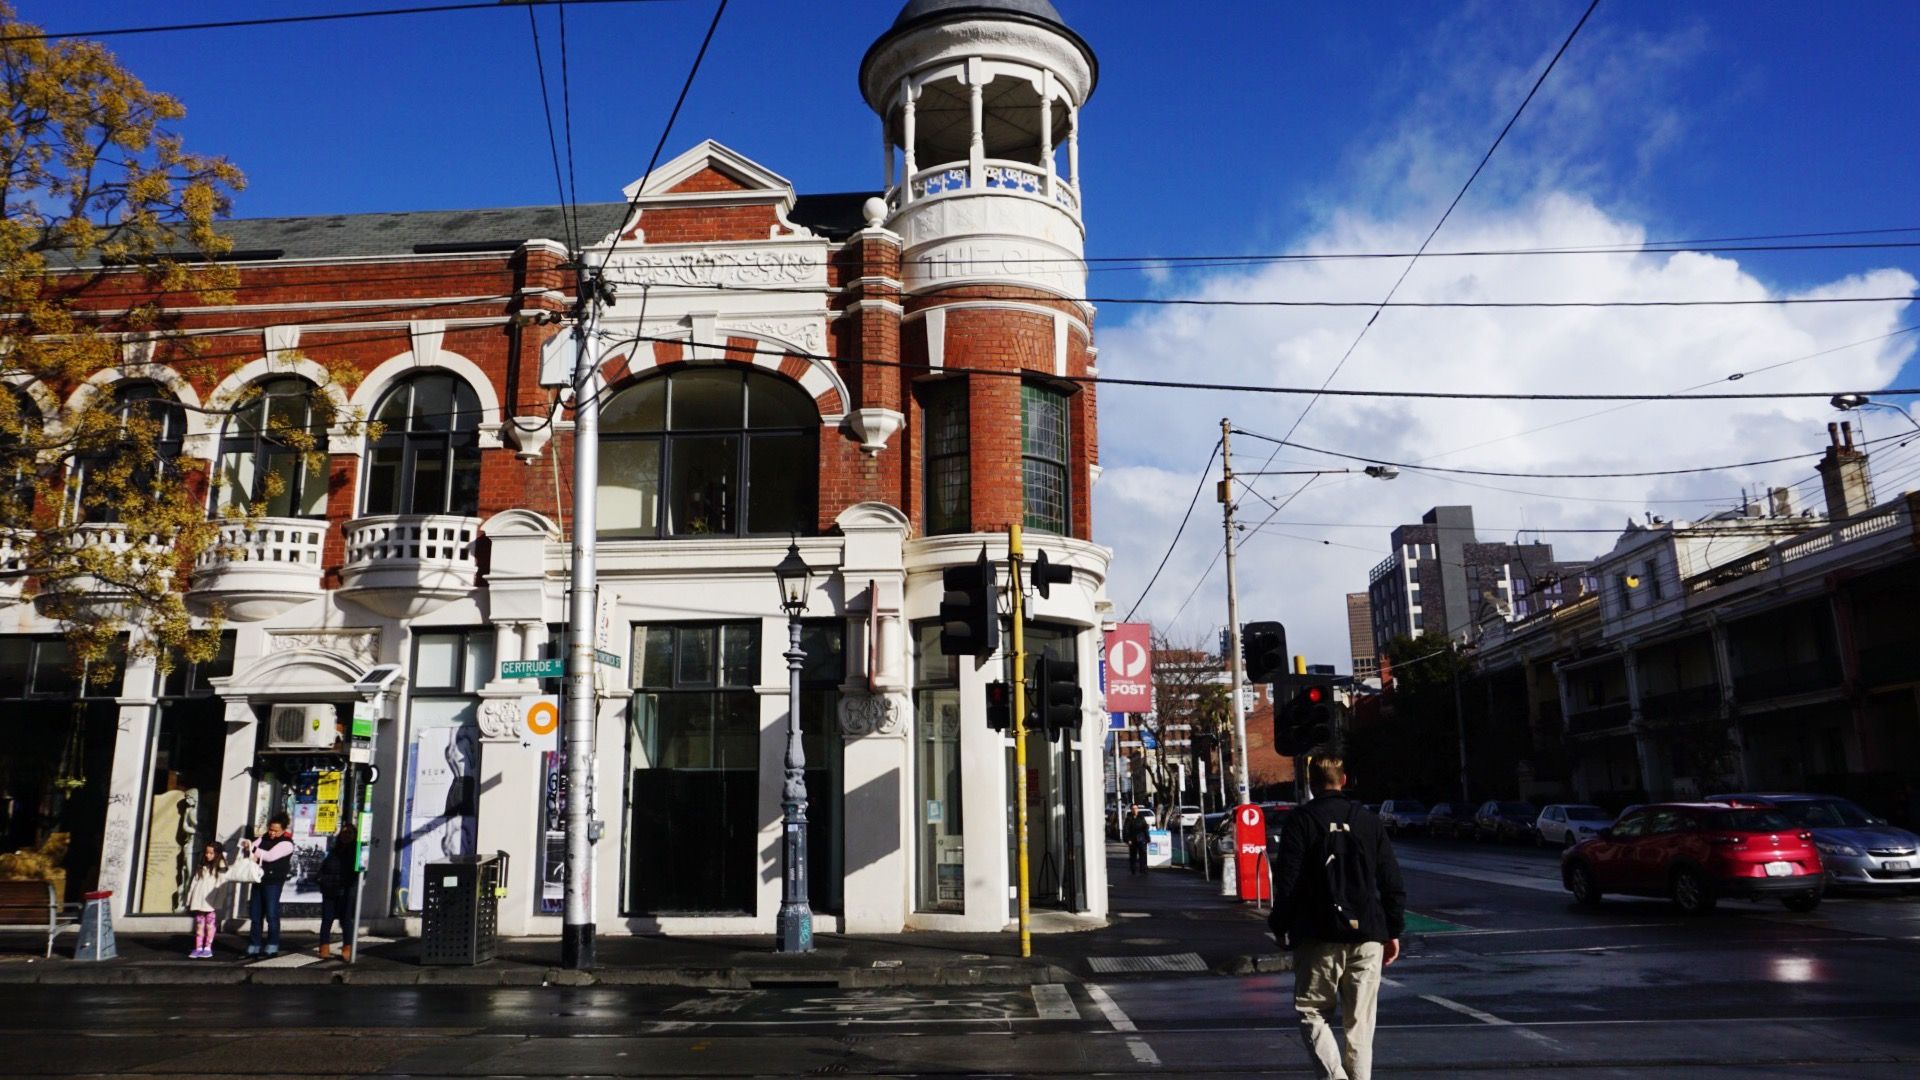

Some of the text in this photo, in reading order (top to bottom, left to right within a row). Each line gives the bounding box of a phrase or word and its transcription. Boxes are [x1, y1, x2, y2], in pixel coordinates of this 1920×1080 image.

[502, 661, 551, 673] GERTRUDE
[1110, 684, 1147, 695] POST
[1242, 846, 1267, 854] POST
